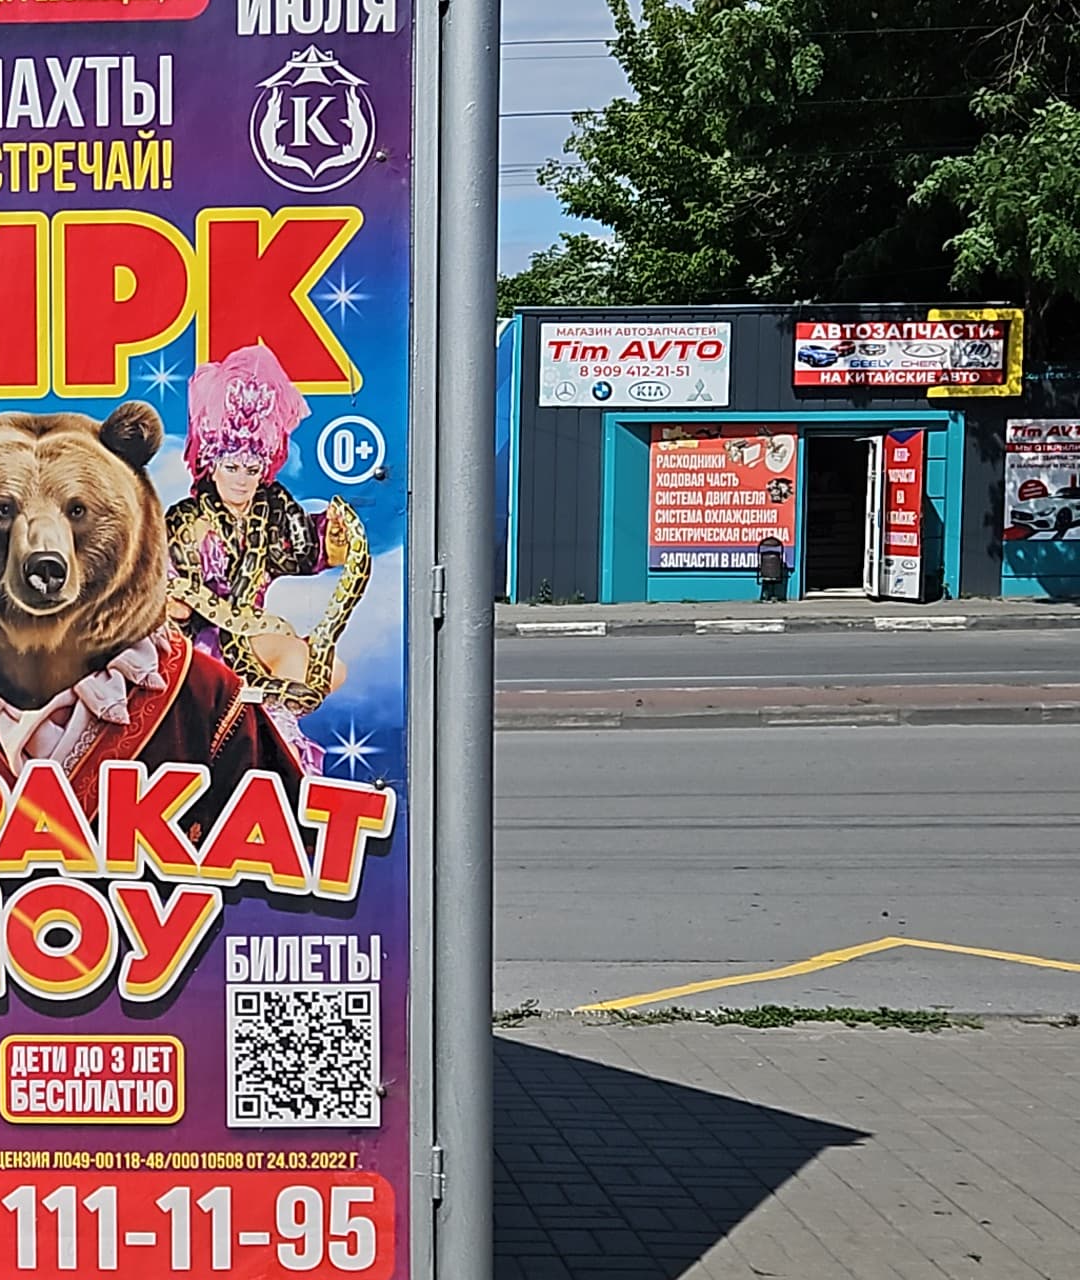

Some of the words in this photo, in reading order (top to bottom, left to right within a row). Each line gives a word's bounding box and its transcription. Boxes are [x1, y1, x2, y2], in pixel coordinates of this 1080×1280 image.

[556, 327, 612, 337] МАГАЗИН
[614, 325, 717, 337] АВТОЗАПЧАСТЕЙ
[810, 322, 994, 340] АВТОЗАПЧАСТИ
[548, 340, 609, 362] Tim
[618, 340, 726, 362] AVTO
[579, 365, 589, 377] 8
[593, 365, 621, 377] 909
[626, 365, 690, 377] 412-21-51
[850, 359, 894, 368] GEELY
[901, 359, 946, 369] CHERY
[820, 373, 842, 384] НА
[846, 370, 936, 384] КИТАЙСКИЕ
[939, 372, 981, 383] АВТО
[333, 428, 374, 473] 0+
[656, 454, 726, 470] РАСХОДНИКИ
[656, 472, 705, 488] ХОДОВАЯ
[706, 472, 740, 487] ЧАСТЬ
[655, 491, 703, 505] СИСТЕМА
[705, 491, 766, 506] ДВИГАТЕЛЯ
[655, 509, 703, 523] СИСТЕМА
[704, 509, 778, 525] ОХЛАЖДЕНИЯ
[654, 527, 740, 542] ЭЛЕКТРИЧЕСКАЯ
[660, 552, 720, 568] ЗАПЧАСТИ
[721, 552, 729, 568] В
[225, 935, 381, 983] БИЛЕТЫ
[10, 1045, 66, 1079] ДЕТИ
[74, 1045, 104, 1078] ДО
[110, 1045, 125, 1074] 3
[132, 1045, 174, 1074] ЛЕТ
[10, 1078, 174, 1114] БЕСПЛАТНО
[246, 1152, 265, 1169] ОТ
[266, 1151, 347, 1170] 24.03.2022
[0, 1183, 377, 1273] 111-11-95
